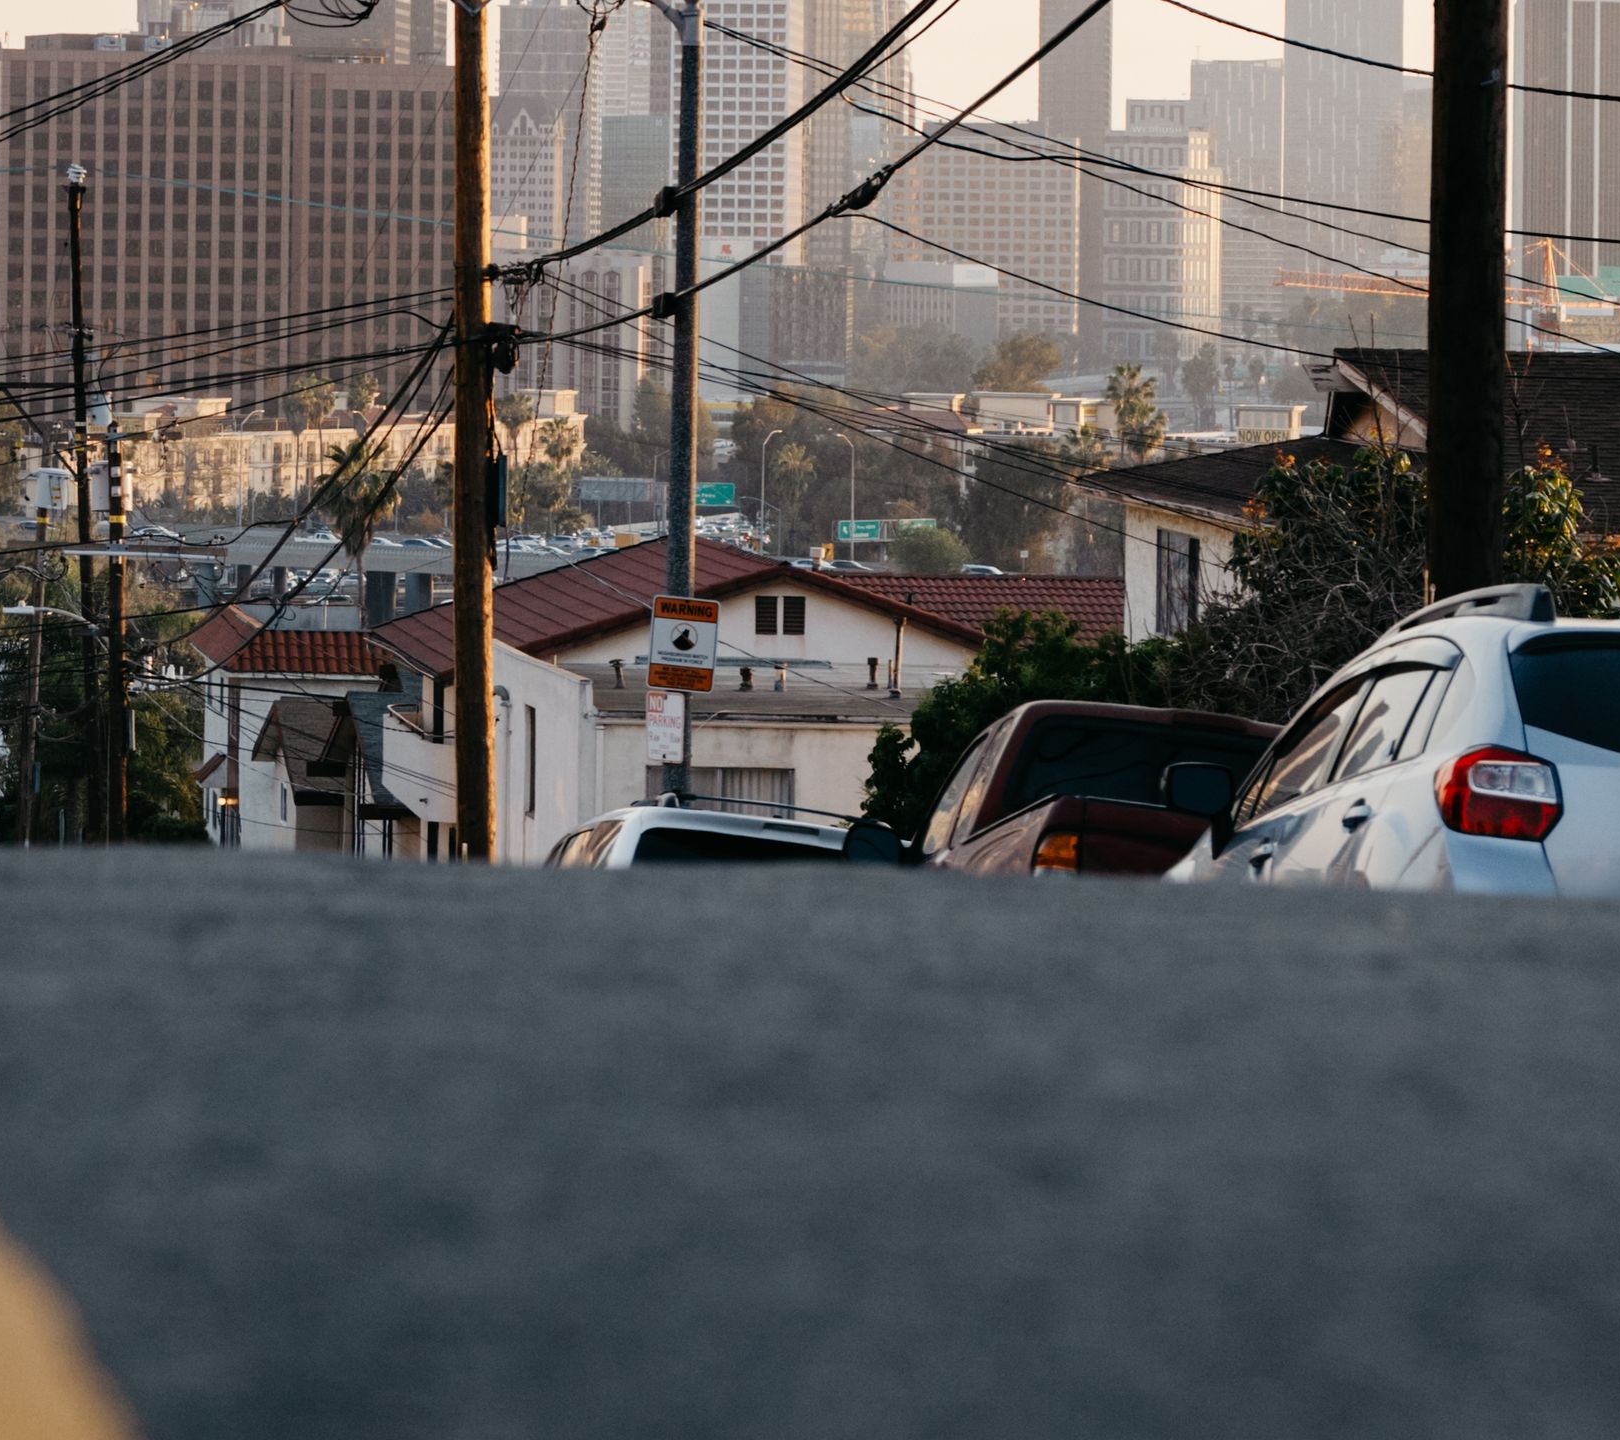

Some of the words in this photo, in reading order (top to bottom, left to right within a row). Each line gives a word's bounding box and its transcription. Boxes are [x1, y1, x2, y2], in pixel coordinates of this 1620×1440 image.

[1238, 430, 1261, 442] NOW
[1264, 431, 1290, 443] OPEN
[661, 601, 713, 618] WARNING
[649, 695, 663, 711] NO
[649, 714, 682, 729] PARKING
